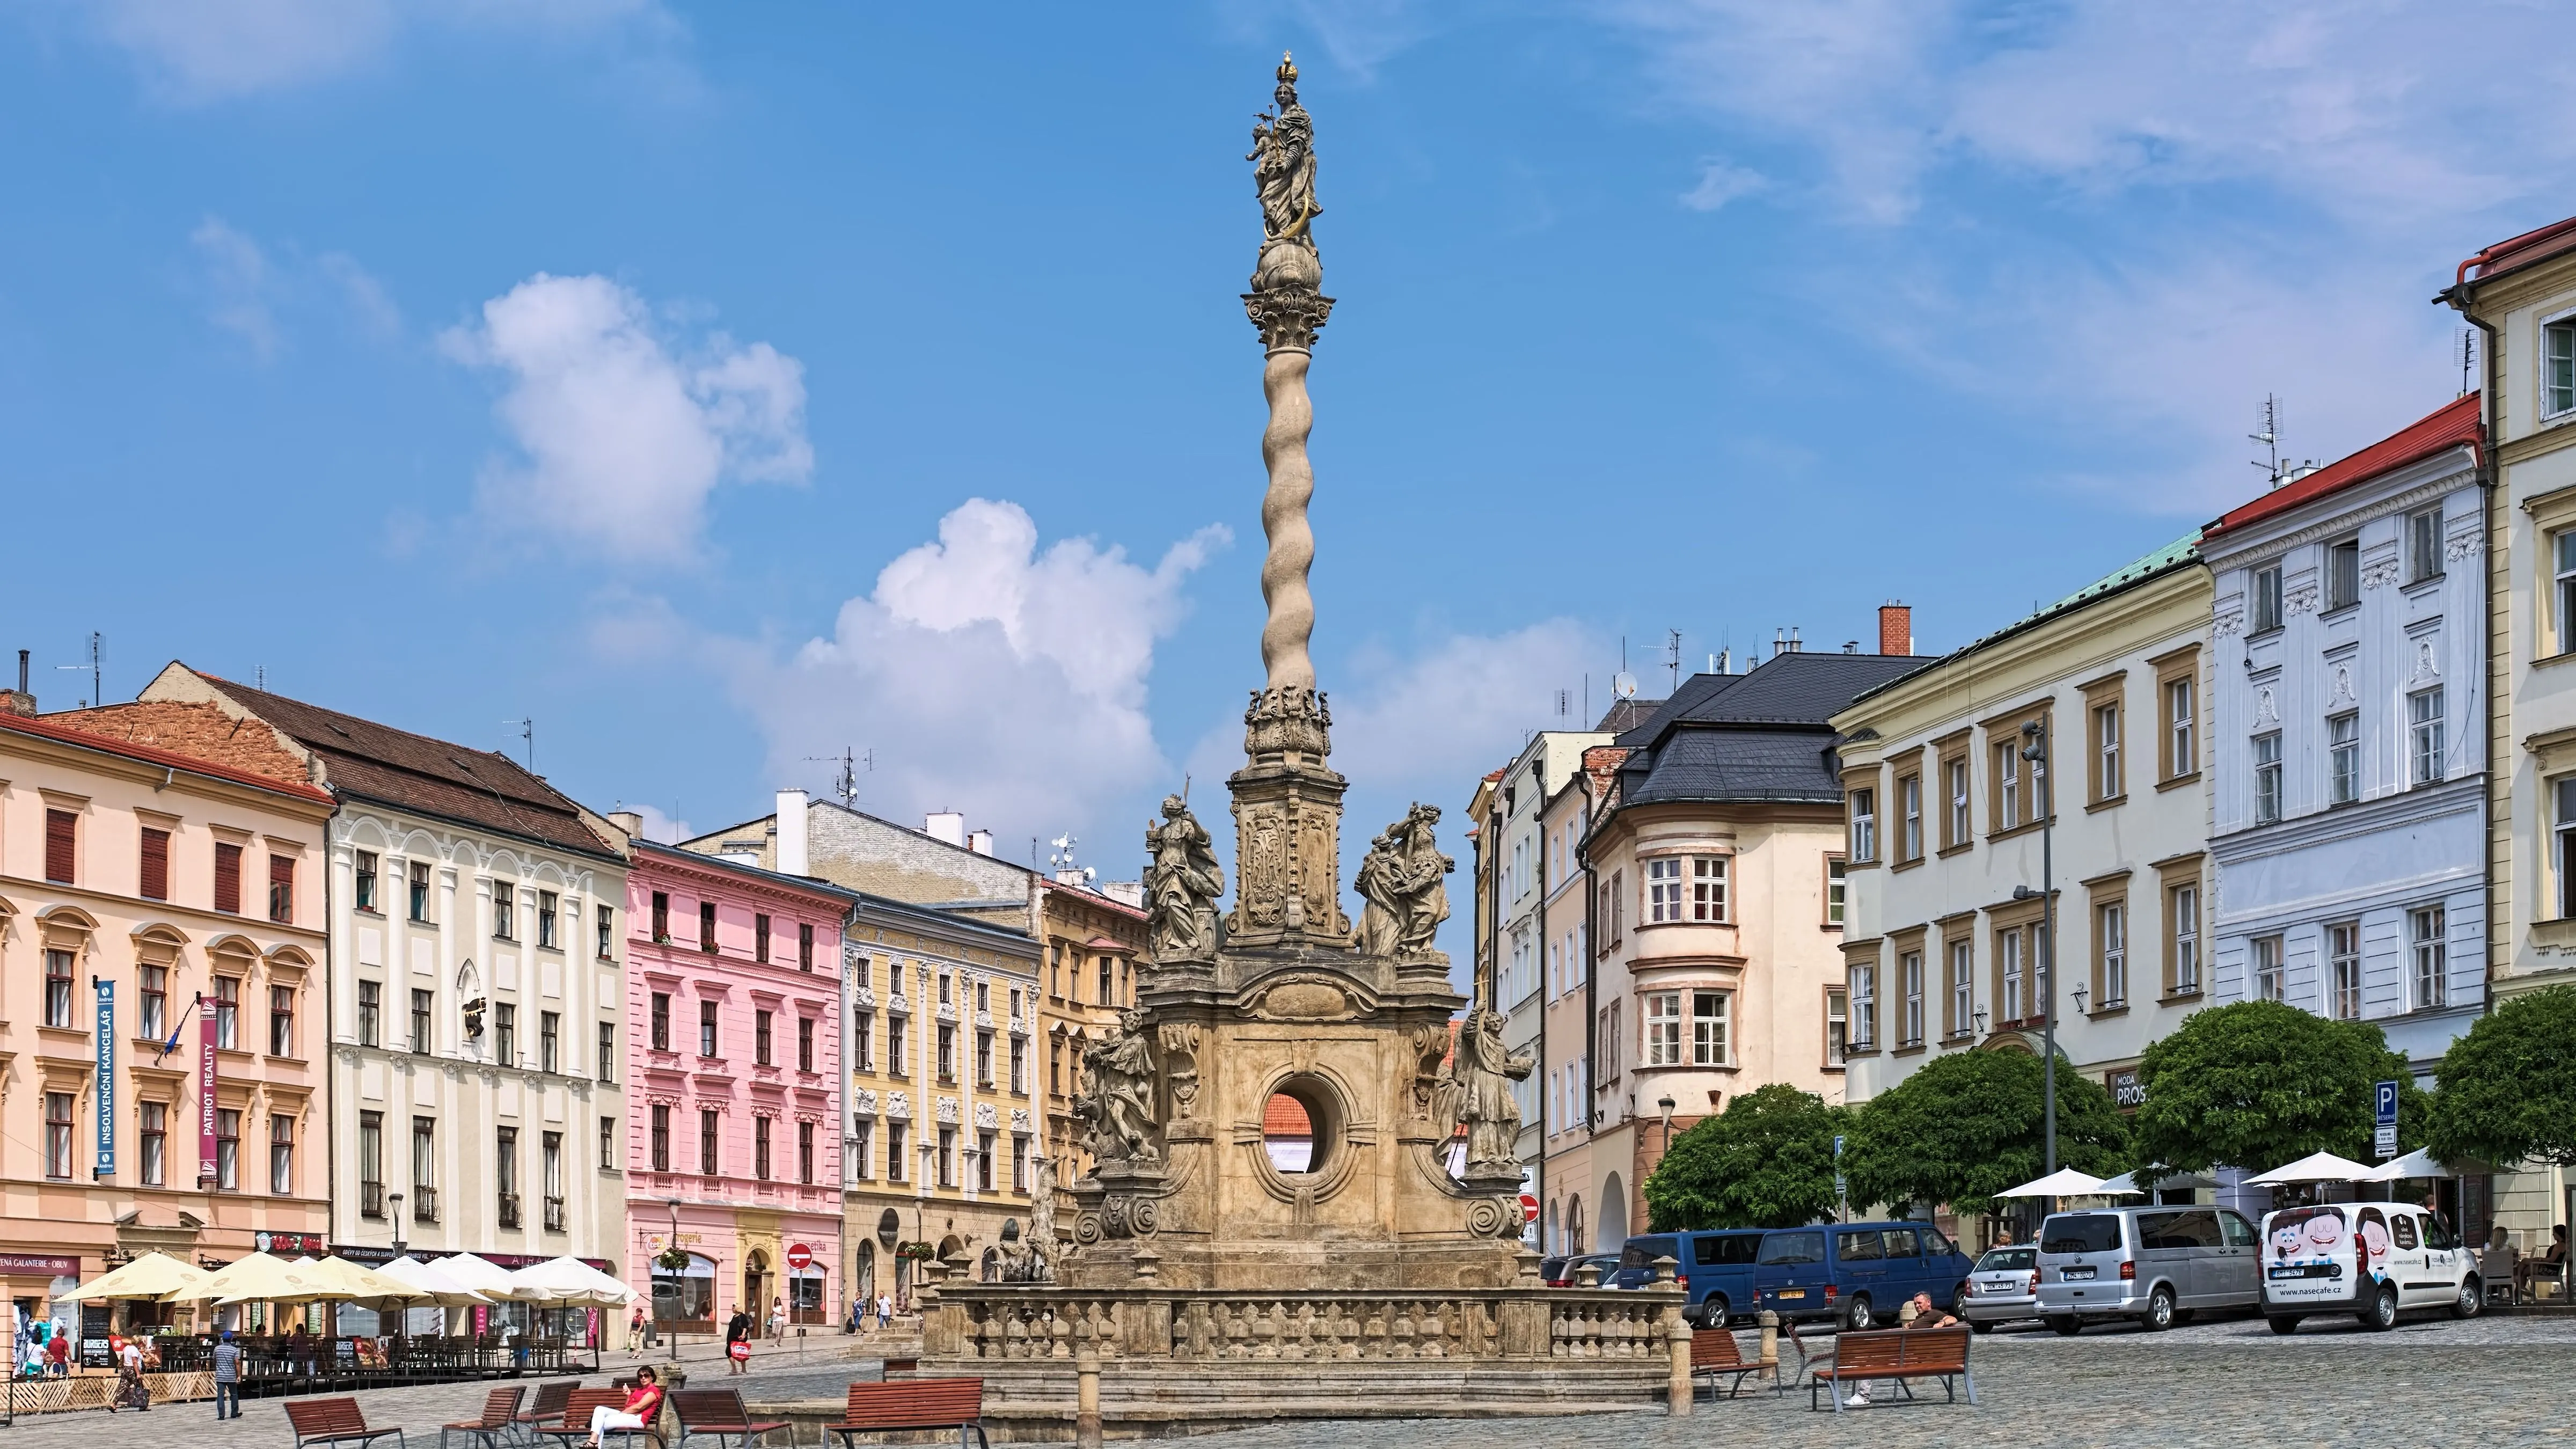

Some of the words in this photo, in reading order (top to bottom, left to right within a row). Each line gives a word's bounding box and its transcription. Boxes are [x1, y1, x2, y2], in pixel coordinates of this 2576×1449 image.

[100, 1011, 111, 1069] KANCELÁŘ
[204, 1043, 213, 1087] REALITY
[2118, 1074, 2135, 1086] MÓDA
[2118, 1085, 2147, 1105] PROS
[2381, 1087, 2392, 1112] P
[100, 1072, 111, 1144] INSOLVENČNÍ
[203, 1092, 213, 1136] PATRIOT
[676, 1232, 702, 1246] rogerie
[342, 1248, 355, 1256] ODĚVY
[361, 1249, 377, 1257] ČESKÝCH
[0, 1257, 12, 1267] ENÁ
[13, 1258, 47, 1268] GALANTERIE
[52, 1260, 68, 1268] OBUV
[511, 1256, 551, 1265] ATRAK
[2280, 1286, 2341, 1296] www.nasecafe.cz
[83, 1339, 109, 1349] BURGERS
[336, 1341, 354, 1350] BURGERS
